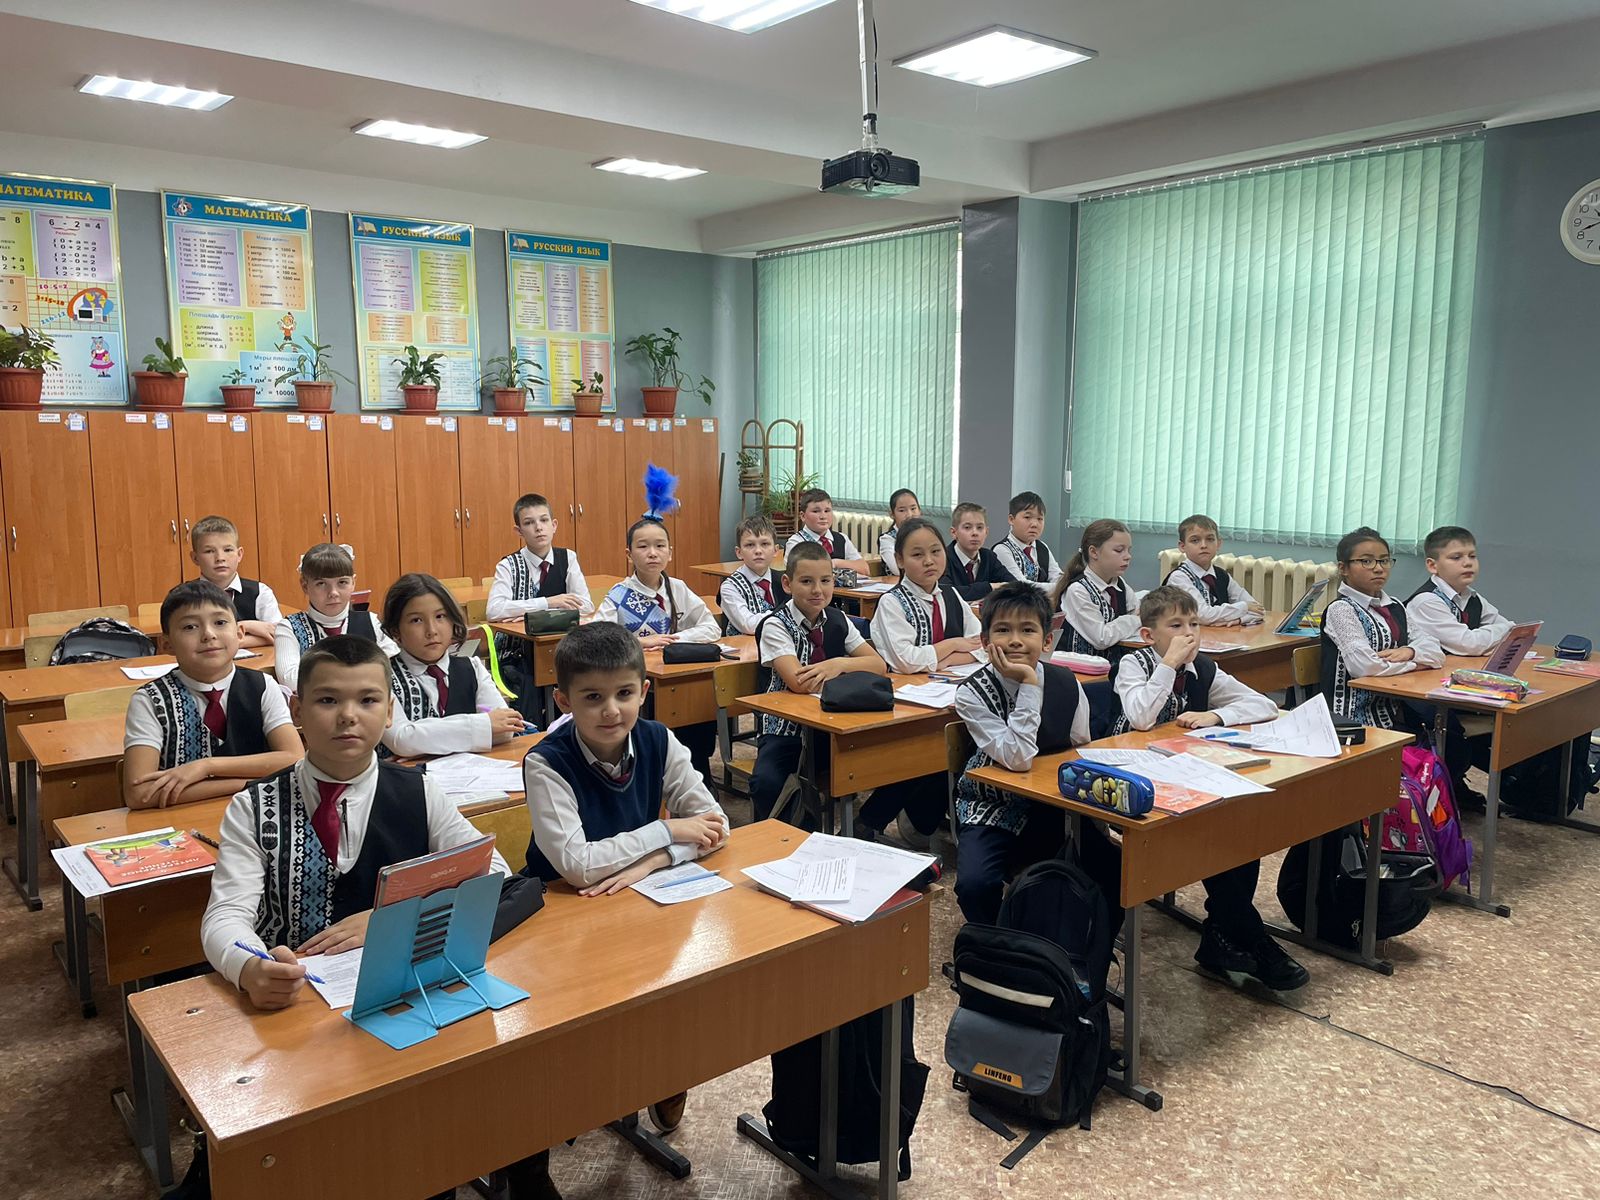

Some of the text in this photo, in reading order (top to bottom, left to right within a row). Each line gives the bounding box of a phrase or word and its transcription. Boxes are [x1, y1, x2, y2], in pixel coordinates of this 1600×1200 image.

[204, 204, 292, 222] МАТЕМАТИКА
[1579, 204, 1590, 213] 10
[1573, 218, 1582, 227] 9
[433, 232, 462, 241] ЯЗЫК
[1576, 231, 1585, 240] 8
[1587, 240, 1594, 248] 7
[534, 242, 601, 256] РУССКИЙ ЯЗЫК
